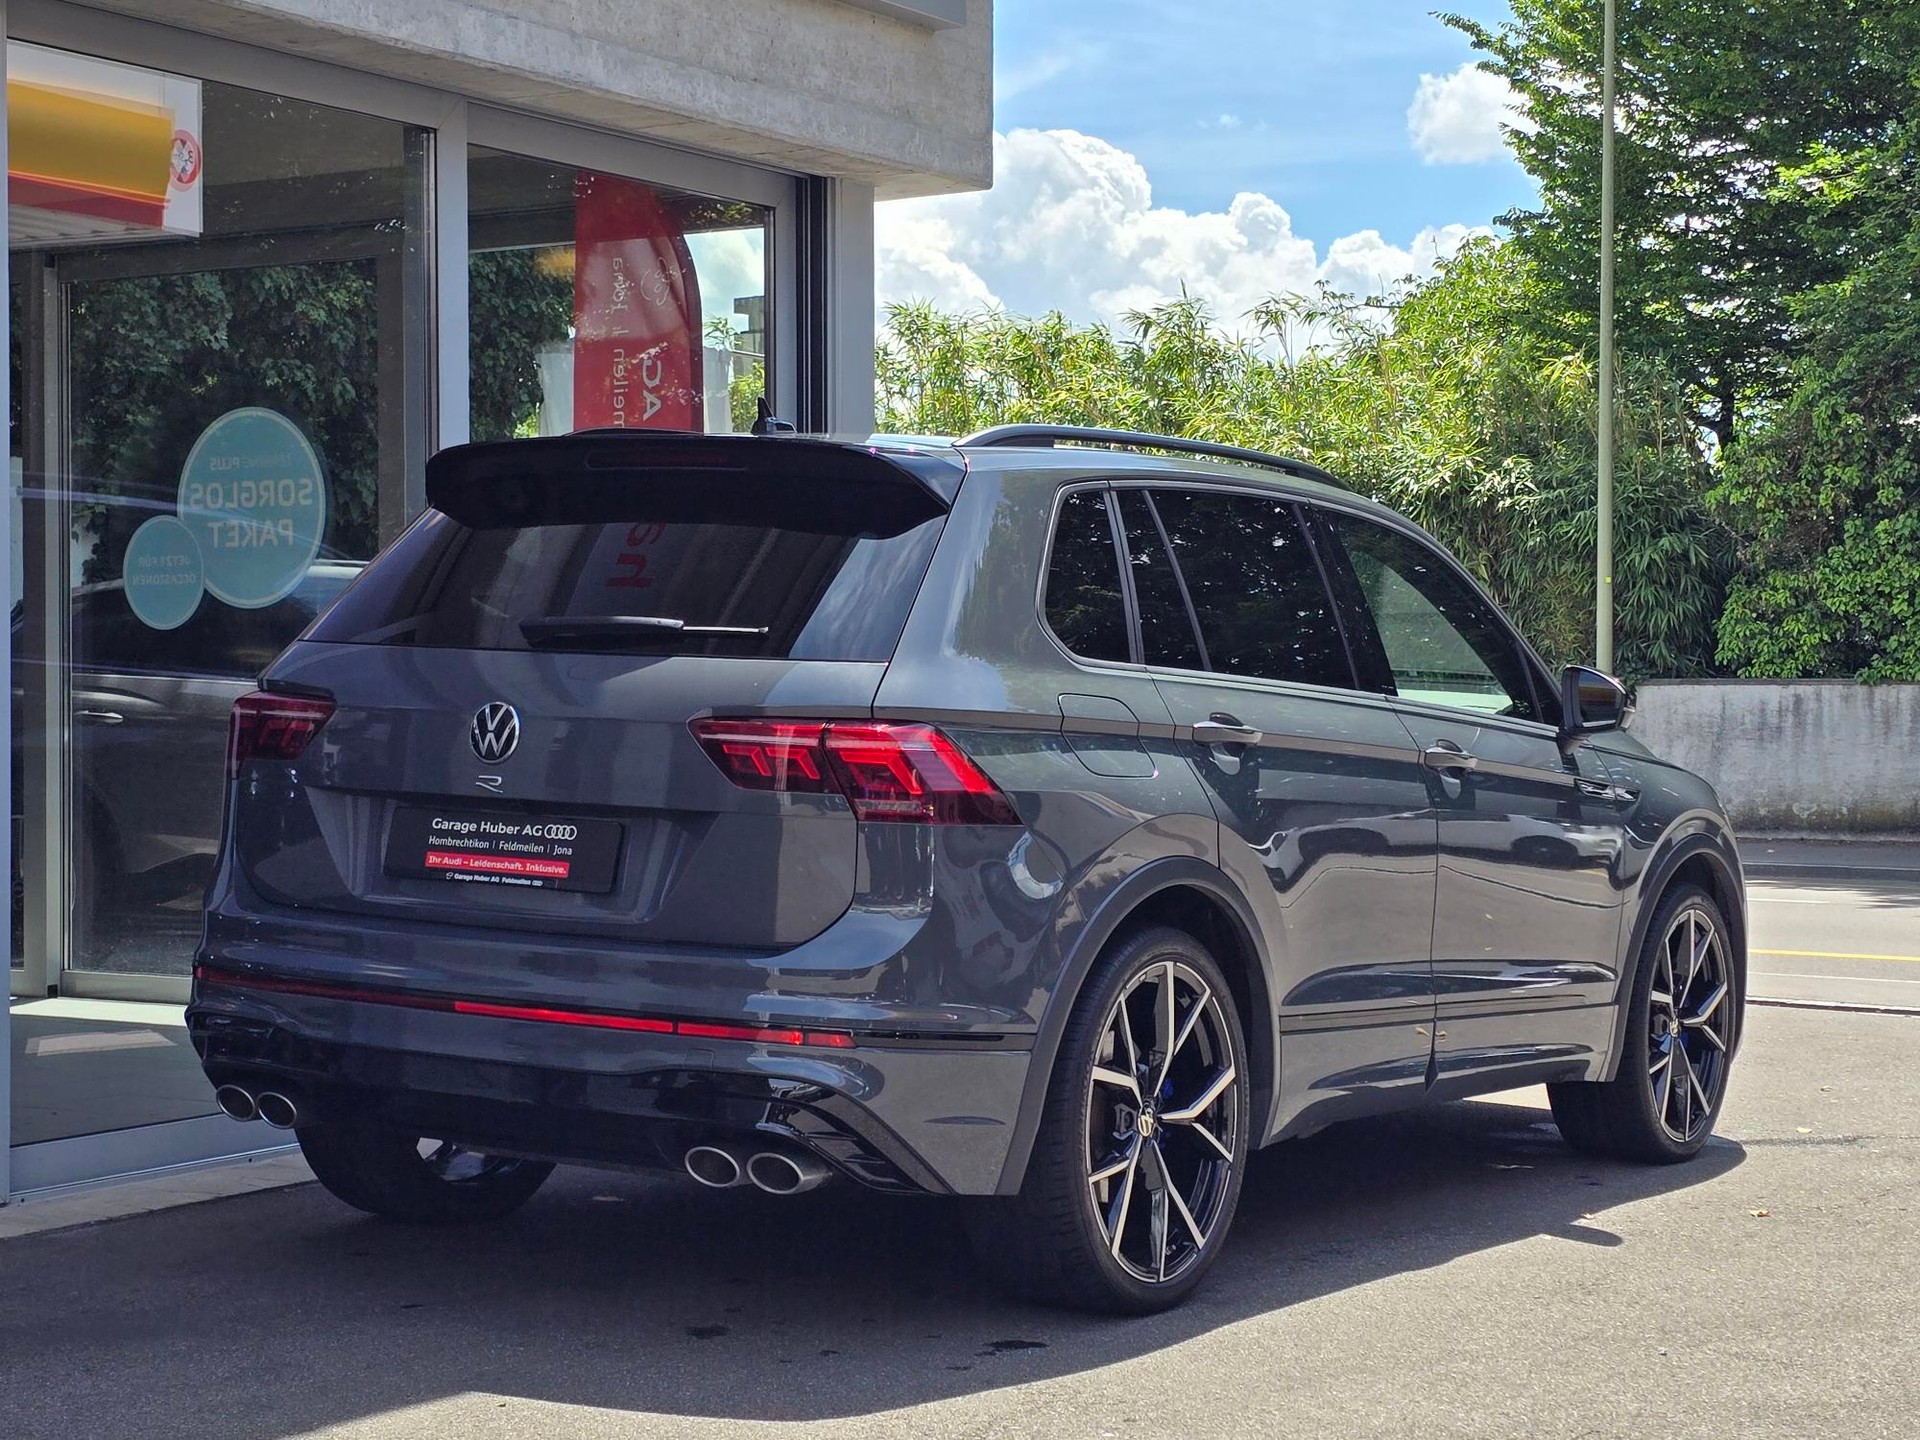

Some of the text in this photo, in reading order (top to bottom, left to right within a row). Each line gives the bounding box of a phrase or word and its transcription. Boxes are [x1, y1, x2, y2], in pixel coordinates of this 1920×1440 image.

[432, 818, 543, 837] Garage Huber AG
[428, 835, 490, 849] Hombrechtikon
[499, 840, 544, 853] Feldmeilen
[553, 844, 573, 856] Jona
[428, 855, 442, 864] Ihr
[442, 857, 462, 865] Audi
[470, 858, 524, 870] Leidenschaft.
[526, 862, 567, 874] Inklusive.
